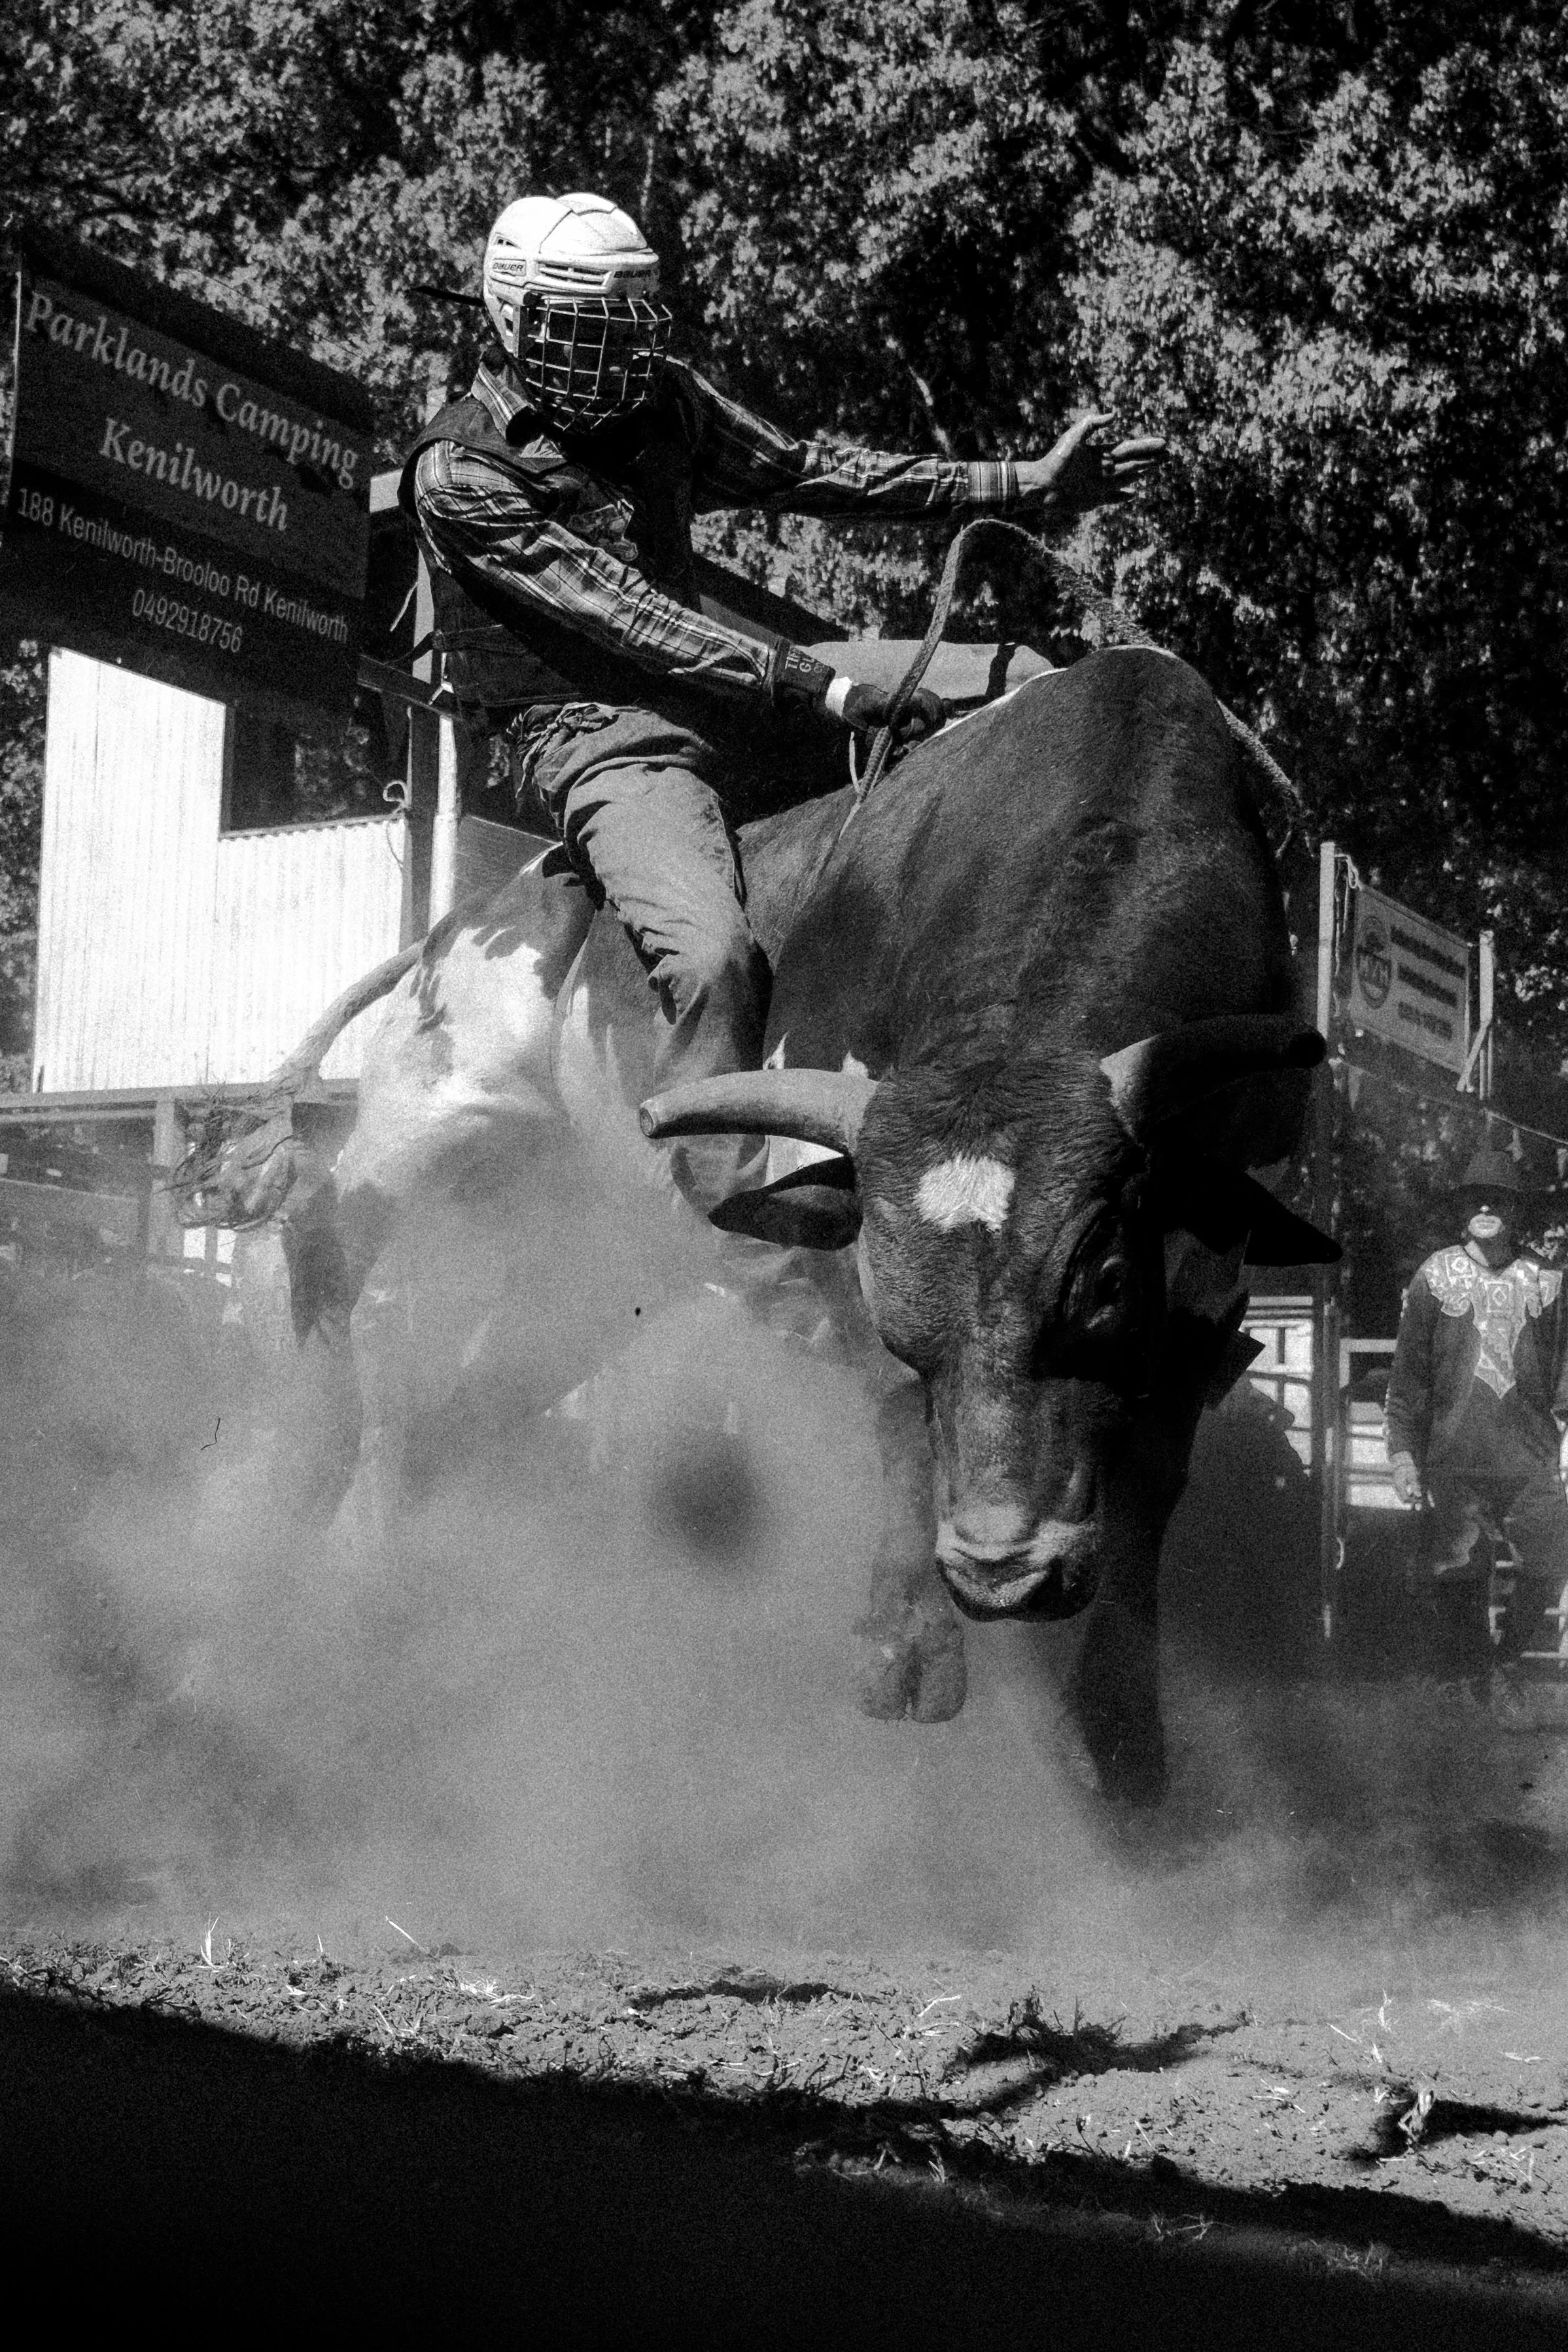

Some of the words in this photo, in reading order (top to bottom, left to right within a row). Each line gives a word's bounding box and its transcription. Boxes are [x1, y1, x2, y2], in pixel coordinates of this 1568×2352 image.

[25, 291, 207, 407] Parklands
[217, 383, 358, 489] Camping
[99, 417, 287, 531] Kenilworth
[18, 487, 54, 526] 188
[60, 503, 230, 597] Kenilworth-Brooloo
[235, 574, 261, 607] Rd
[264, 588, 348, 644] Kenilworth
[133, 589, 243, 653] 0492918756
